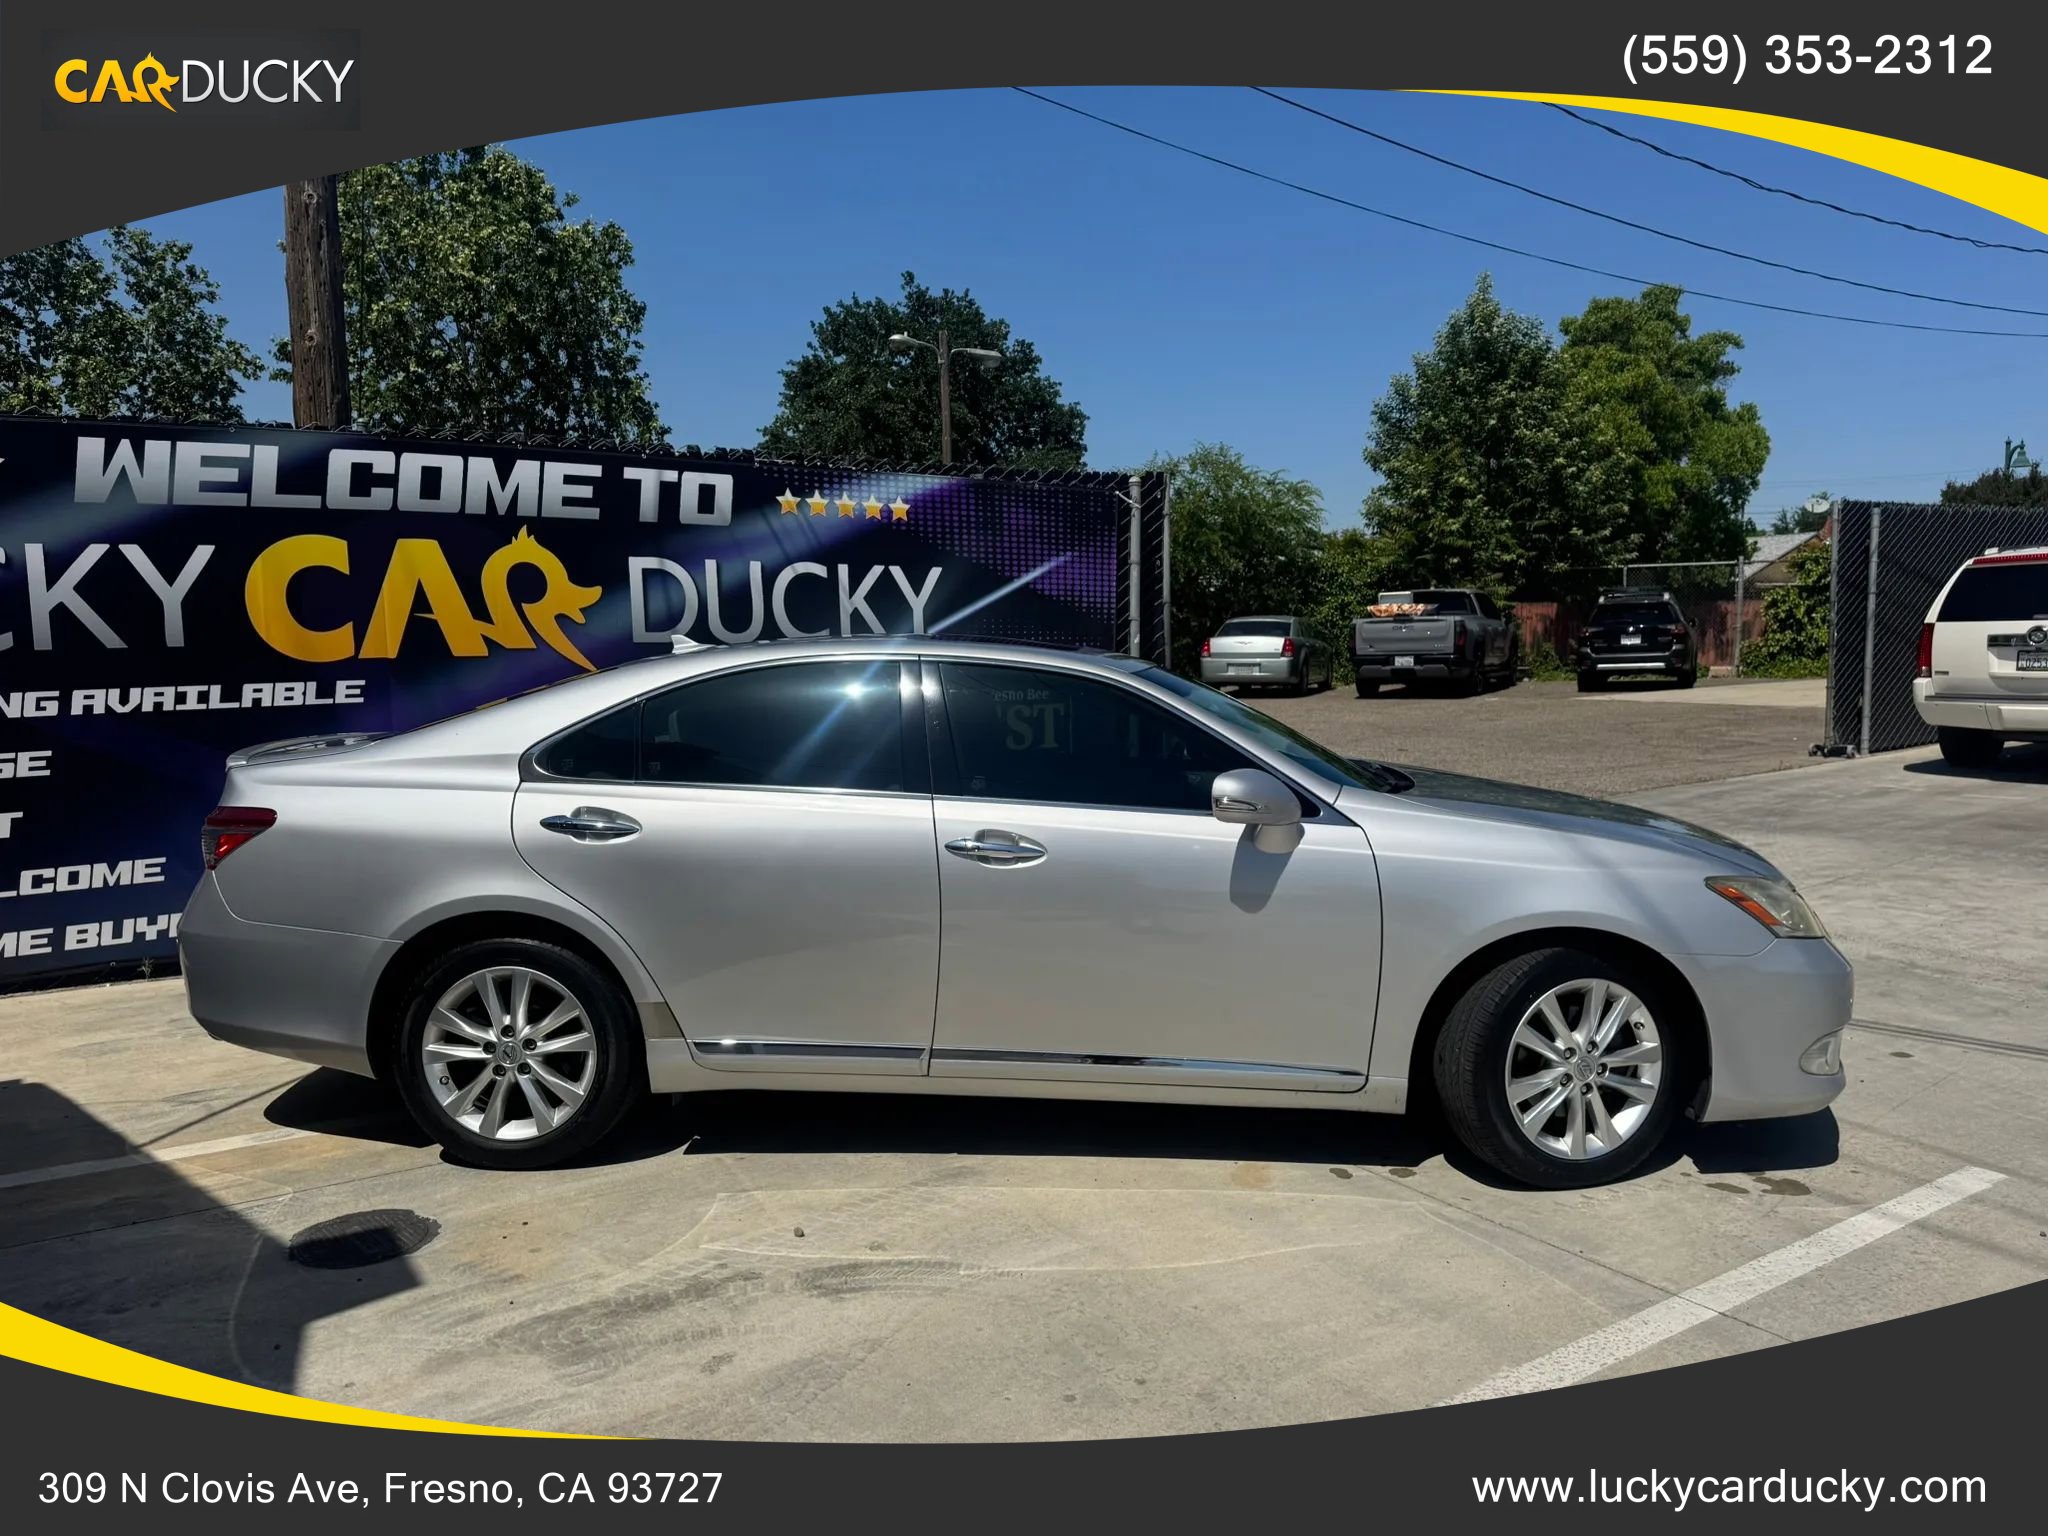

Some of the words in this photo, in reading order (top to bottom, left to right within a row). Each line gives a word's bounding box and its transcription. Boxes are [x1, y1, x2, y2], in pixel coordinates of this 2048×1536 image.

[74, 436, 601, 520] WELCOME
[622, 467, 734, 526] TO
[0, 541, 216, 651] KY
[244, 524, 603, 671] CAR
[627, 556, 943, 645] DUCKY
[70, 680, 366, 716] AVAILABLE
